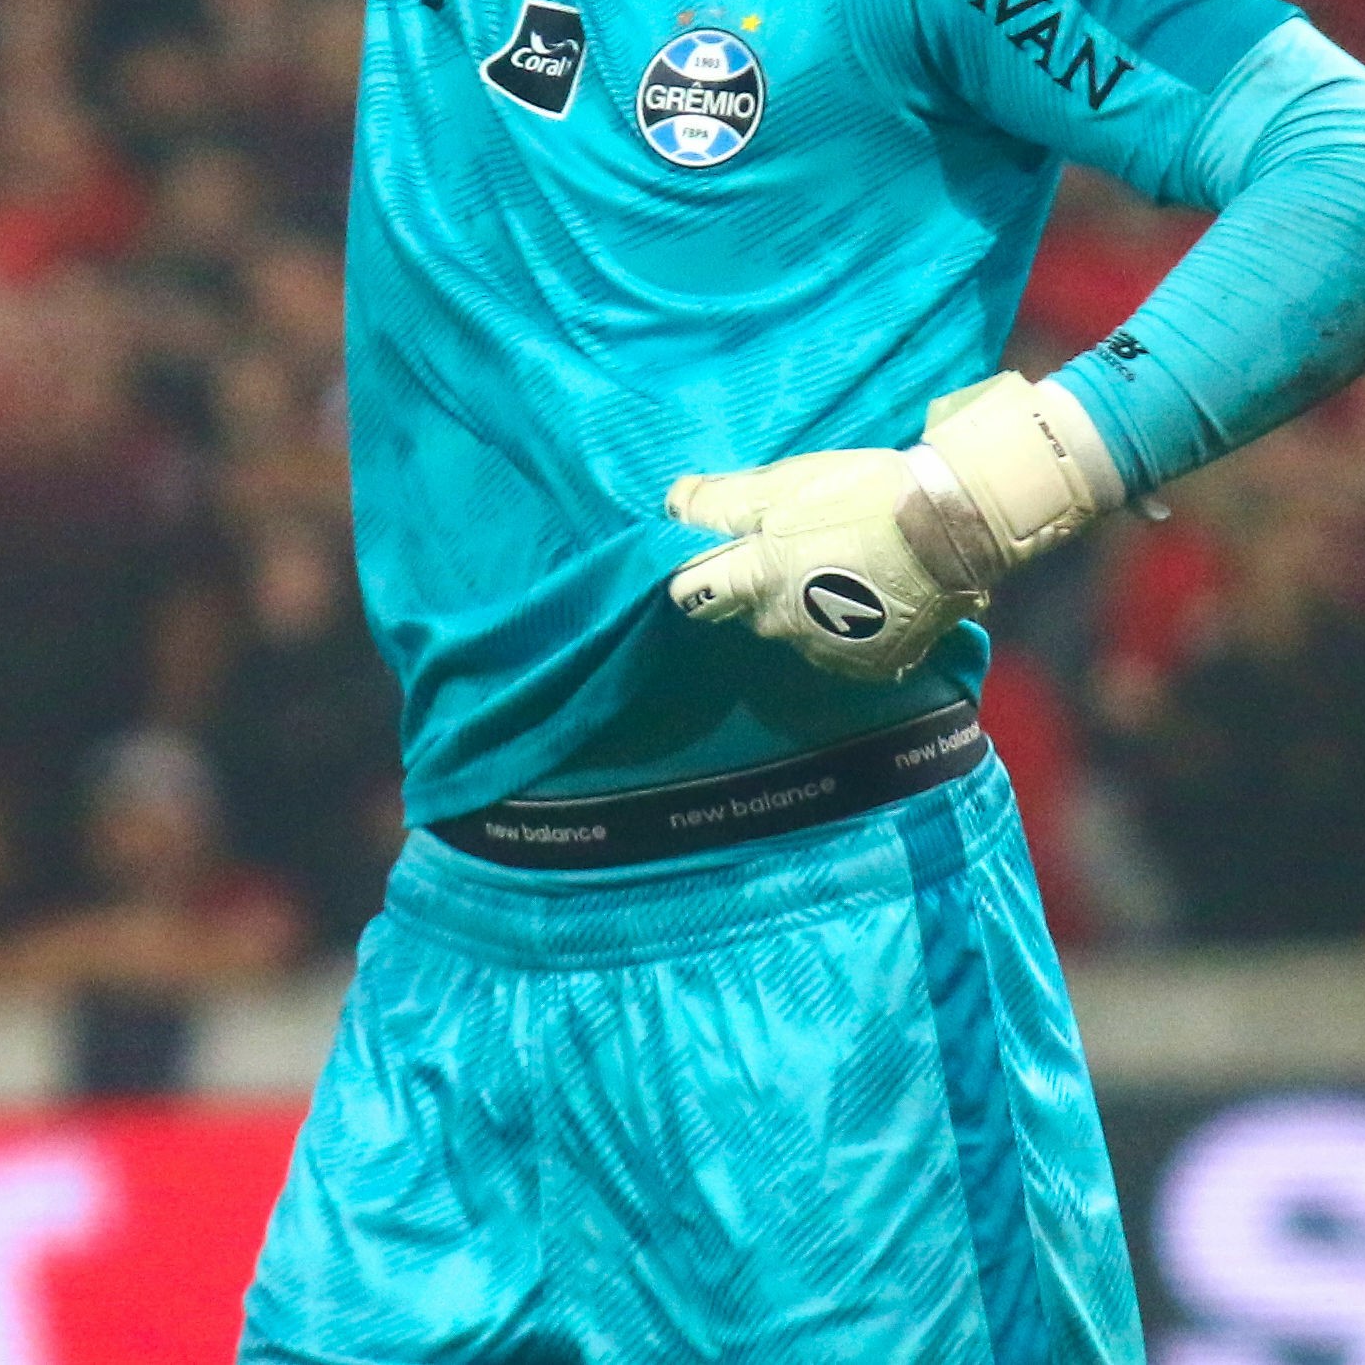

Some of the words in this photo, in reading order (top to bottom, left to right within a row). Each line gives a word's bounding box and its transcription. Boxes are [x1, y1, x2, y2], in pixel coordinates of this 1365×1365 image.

[510, 47, 567, 77] Coral
[645, 81, 756, 118] GRÊMIO
[895, 743, 937, 769] new
[669, 804, 725, 828] new
[731, 776, 837, 817] balance
[485, 822, 519, 840] new
[521, 823, 607, 842] balance
